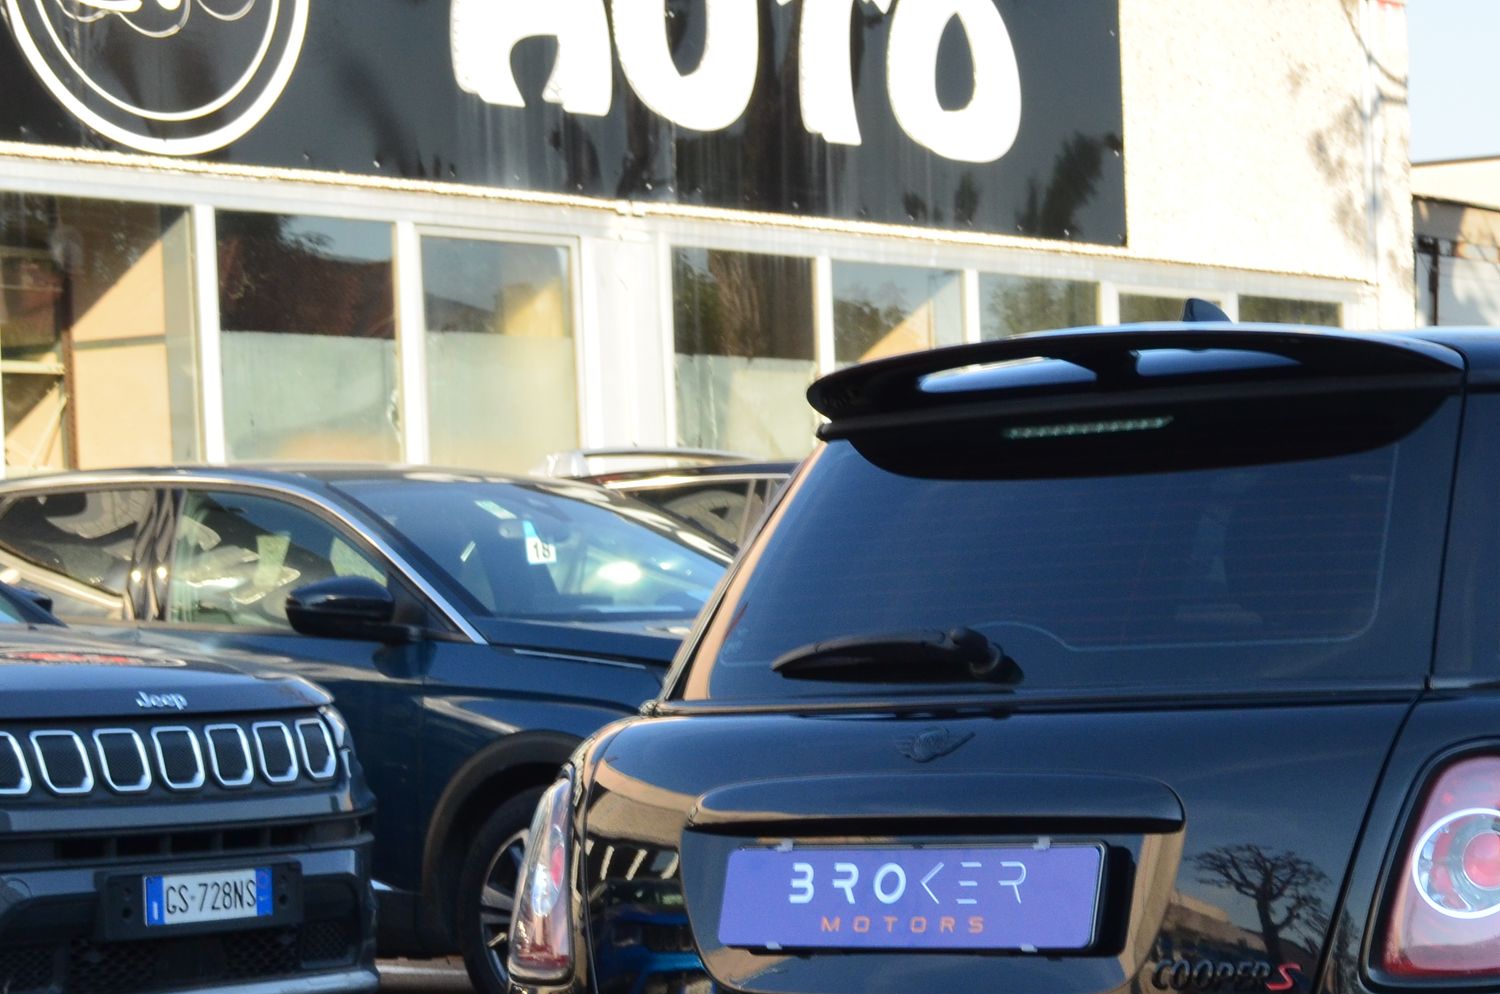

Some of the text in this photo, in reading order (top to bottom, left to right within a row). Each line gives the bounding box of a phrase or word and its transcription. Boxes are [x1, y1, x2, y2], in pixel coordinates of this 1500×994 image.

[135, 690, 188, 711] Jeep
[788, 861, 1028, 905] BROKER
[820, 915, 986, 935] MOTORS
[1264, 961, 1303, 992] S
